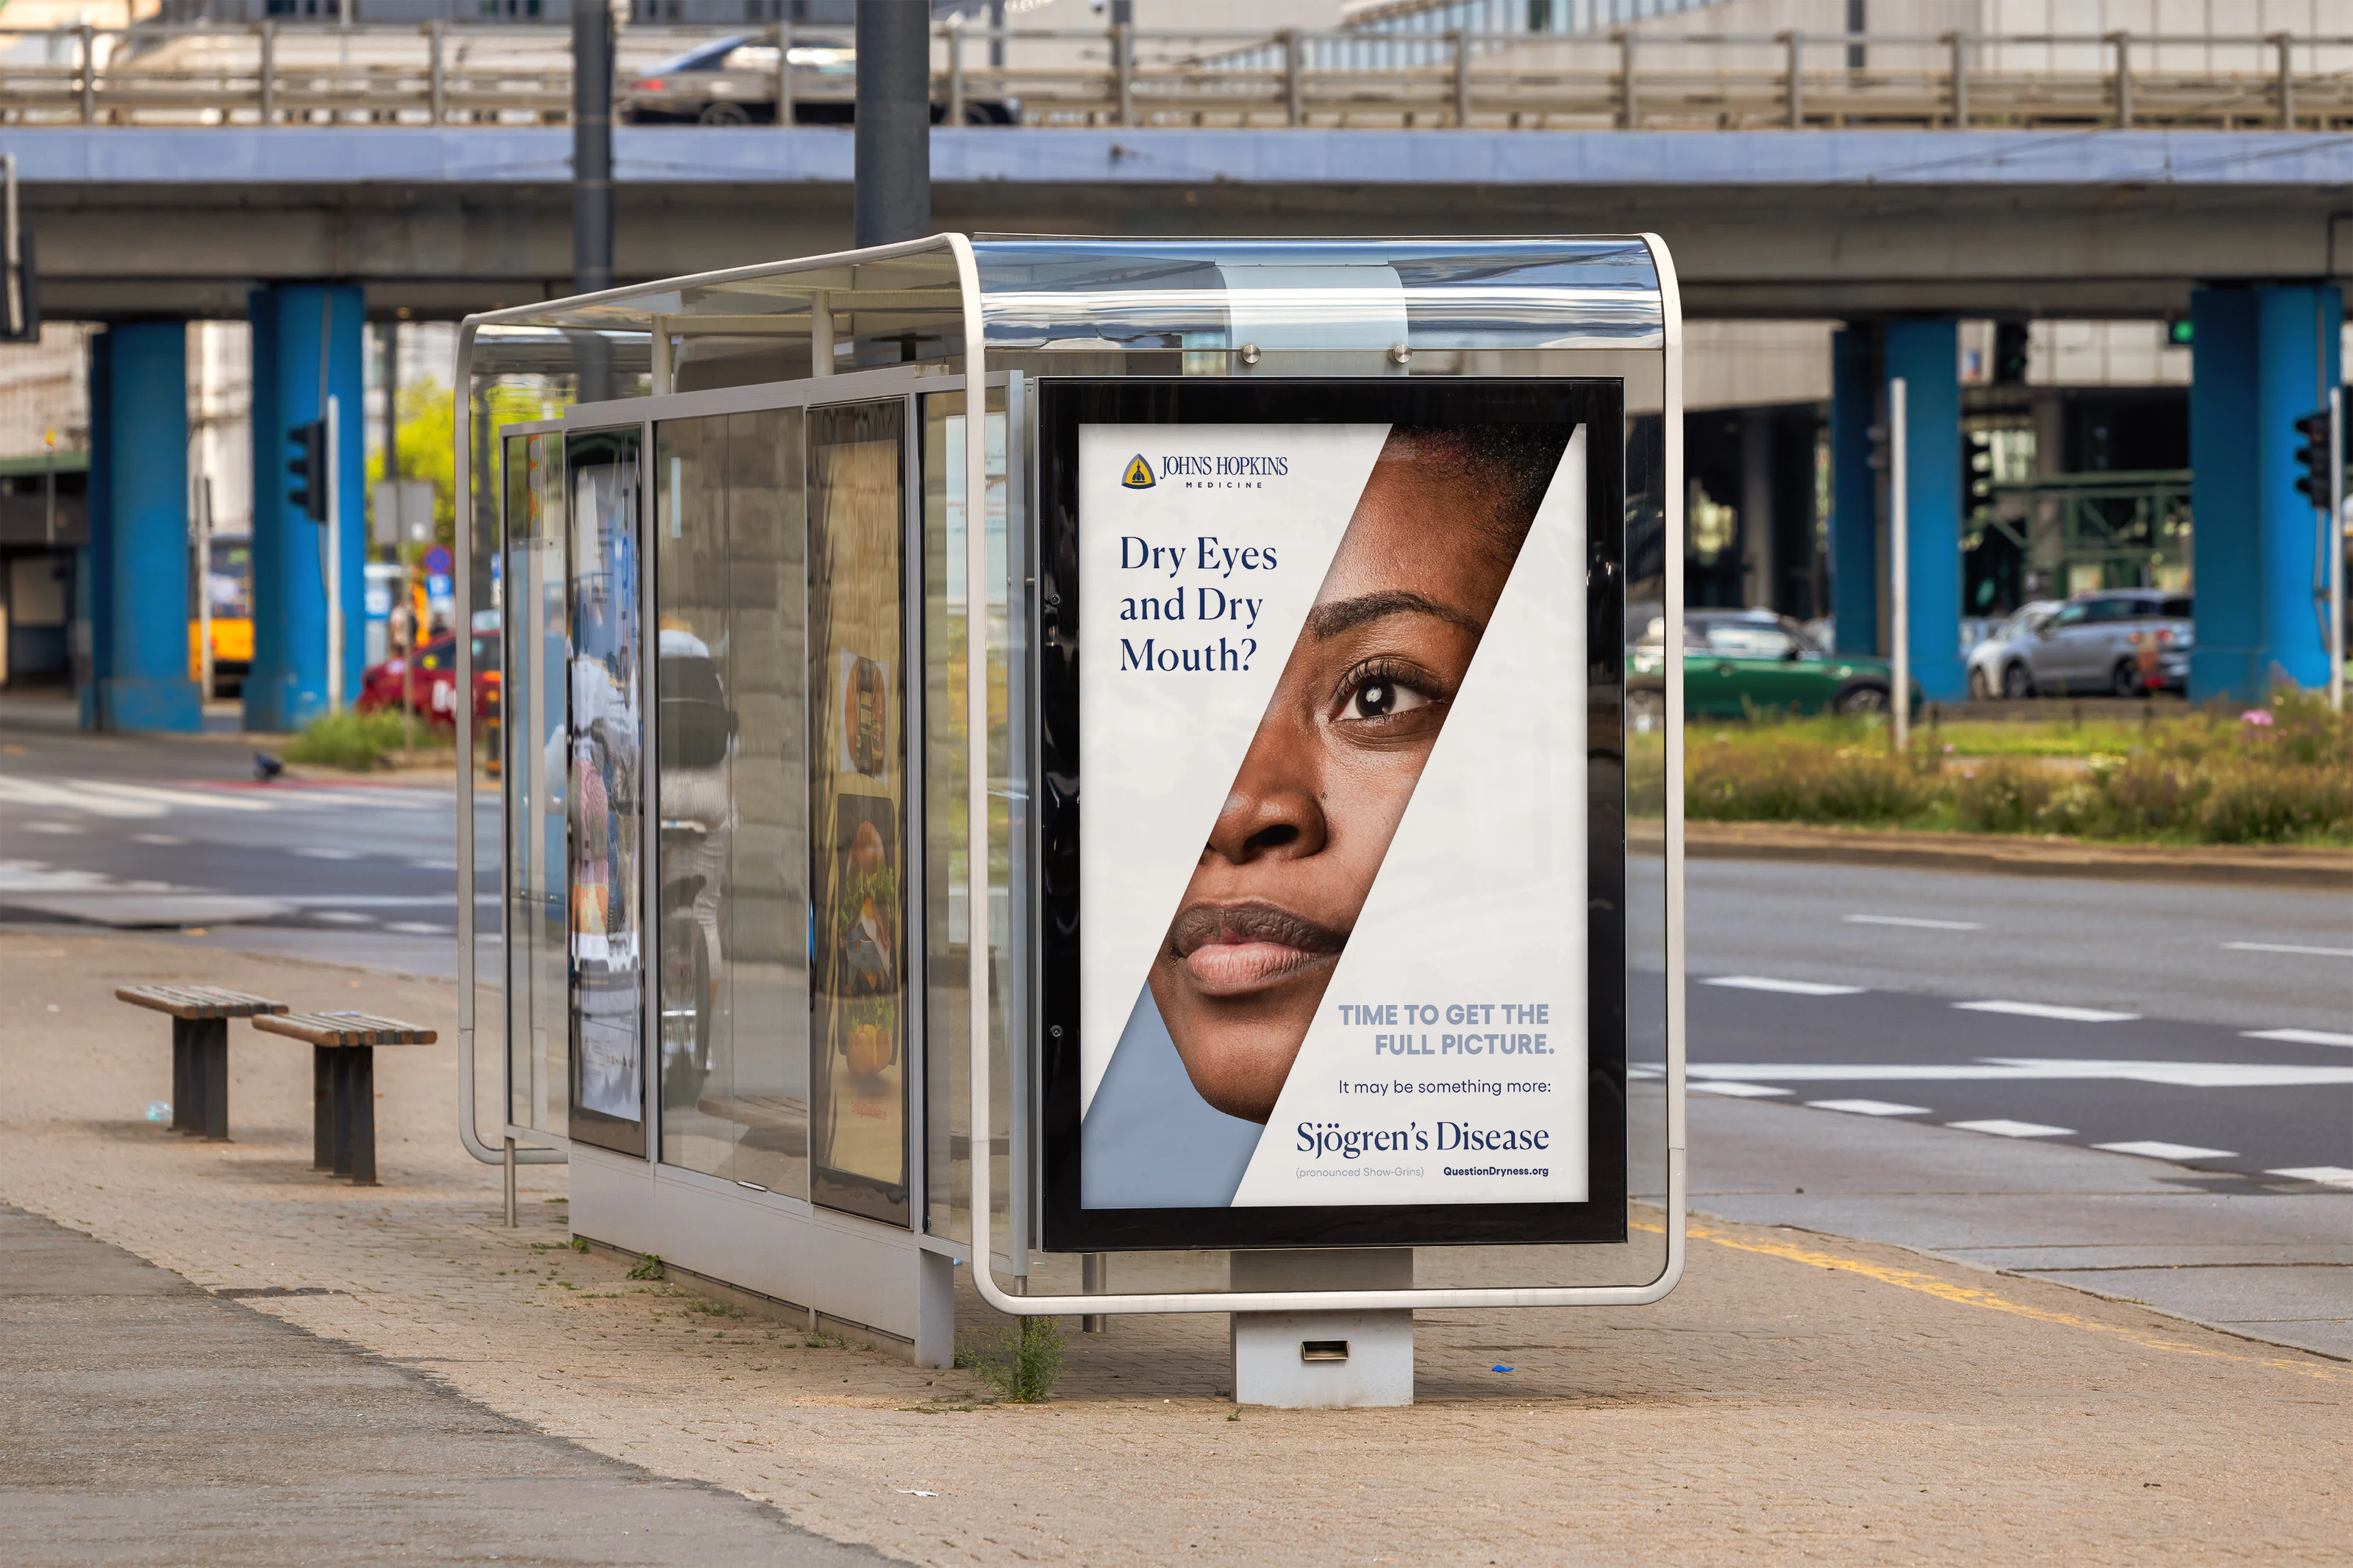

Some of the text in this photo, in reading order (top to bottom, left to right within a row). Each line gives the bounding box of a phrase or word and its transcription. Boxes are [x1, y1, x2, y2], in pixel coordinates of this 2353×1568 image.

[1160, 456, 1288, 480] JOHNS HOPKINS
[1121, 536, 1278, 579] Dry Eyes
[1120, 585, 1264, 630] and Dry
[1120, 637, 1257, 672] Mouth?
[1338, 1003, 1549, 1025] TIME TO GET THE
[1375, 1034, 1555, 1056] FULL PICTURE.
[1339, 1078, 1552, 1097] It may be something more:
[1296, 1120, 1550, 1159] Sjögren’s Disease
[1296, 1166, 1424, 1179] (pronounced Show-Grins)
[1443, 1166, 1549, 1178] QuestionDryness.org
